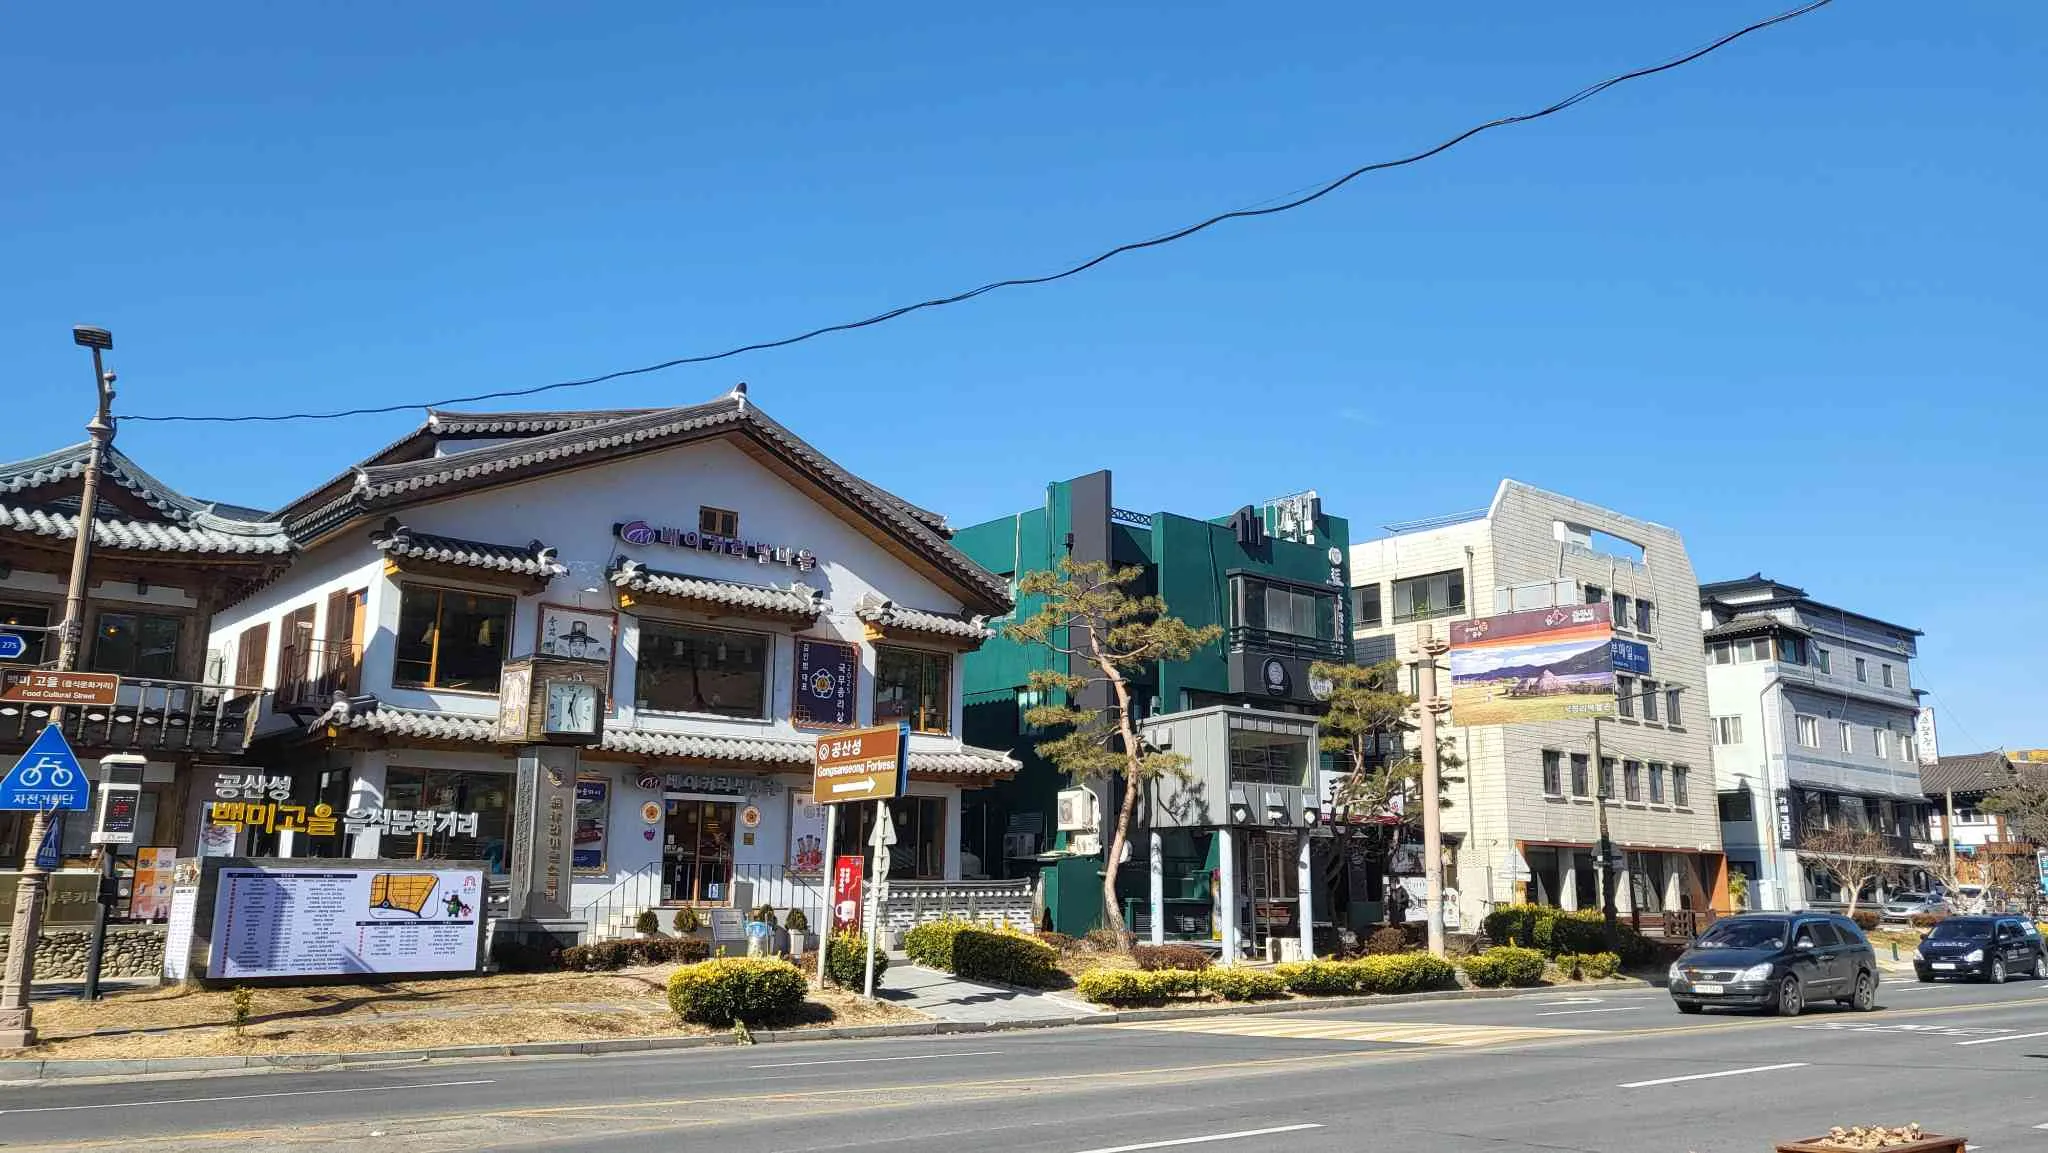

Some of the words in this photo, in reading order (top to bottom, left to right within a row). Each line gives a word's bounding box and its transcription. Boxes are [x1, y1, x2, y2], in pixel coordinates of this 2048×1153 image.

[2, 641, 17, 649] 275
[34, 676, 59, 688] 고을
[73, 692, 95, 700] Street
[837, 663, 845, 722] 국무총리상
[831, 738, 862, 758] 공산성
[817, 763, 865, 777] Gongsanseong
[866, 760, 895, 772] Fortress
[214, 774, 292, 800] 공산성
[13, 793, 75, 805] 자전거횡단
[211, 801, 338, 836] 백미고을
[343, 807, 479, 838] 음식문화거리
